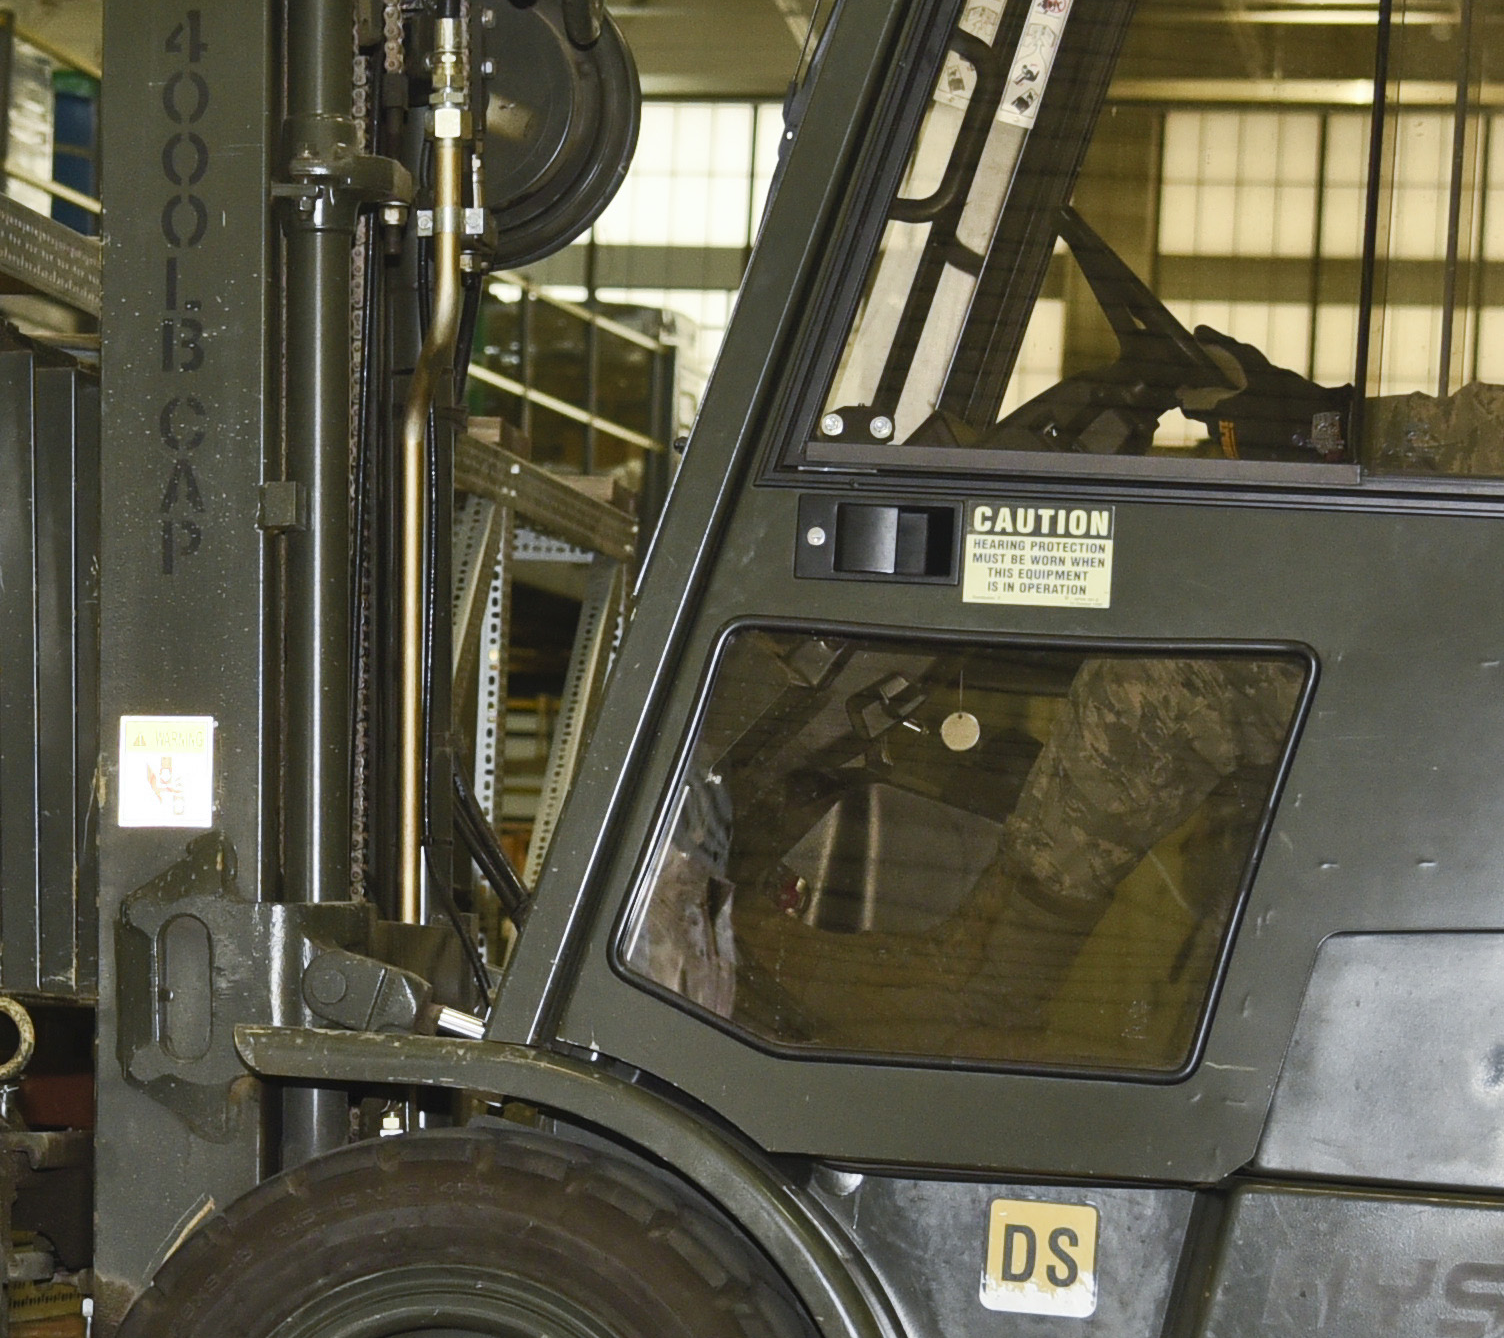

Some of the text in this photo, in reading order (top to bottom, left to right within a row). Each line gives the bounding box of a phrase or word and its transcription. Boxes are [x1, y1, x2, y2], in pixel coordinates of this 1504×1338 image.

[159, 397, 206, 575] CAP
[973, 506, 1110, 536] CAUTION
[973, 538, 1106, 554] HEARING PROTECTION
[972, 553, 1106, 569] MUST BE WORN WHEN
[988, 567, 1089, 581] THIS EQUIPMENT
[988, 581, 1087, 596] IS IN OPERATION
[155, 728, 205, 749] WARNING
[1001, 1223, 1079, 1288] DS
